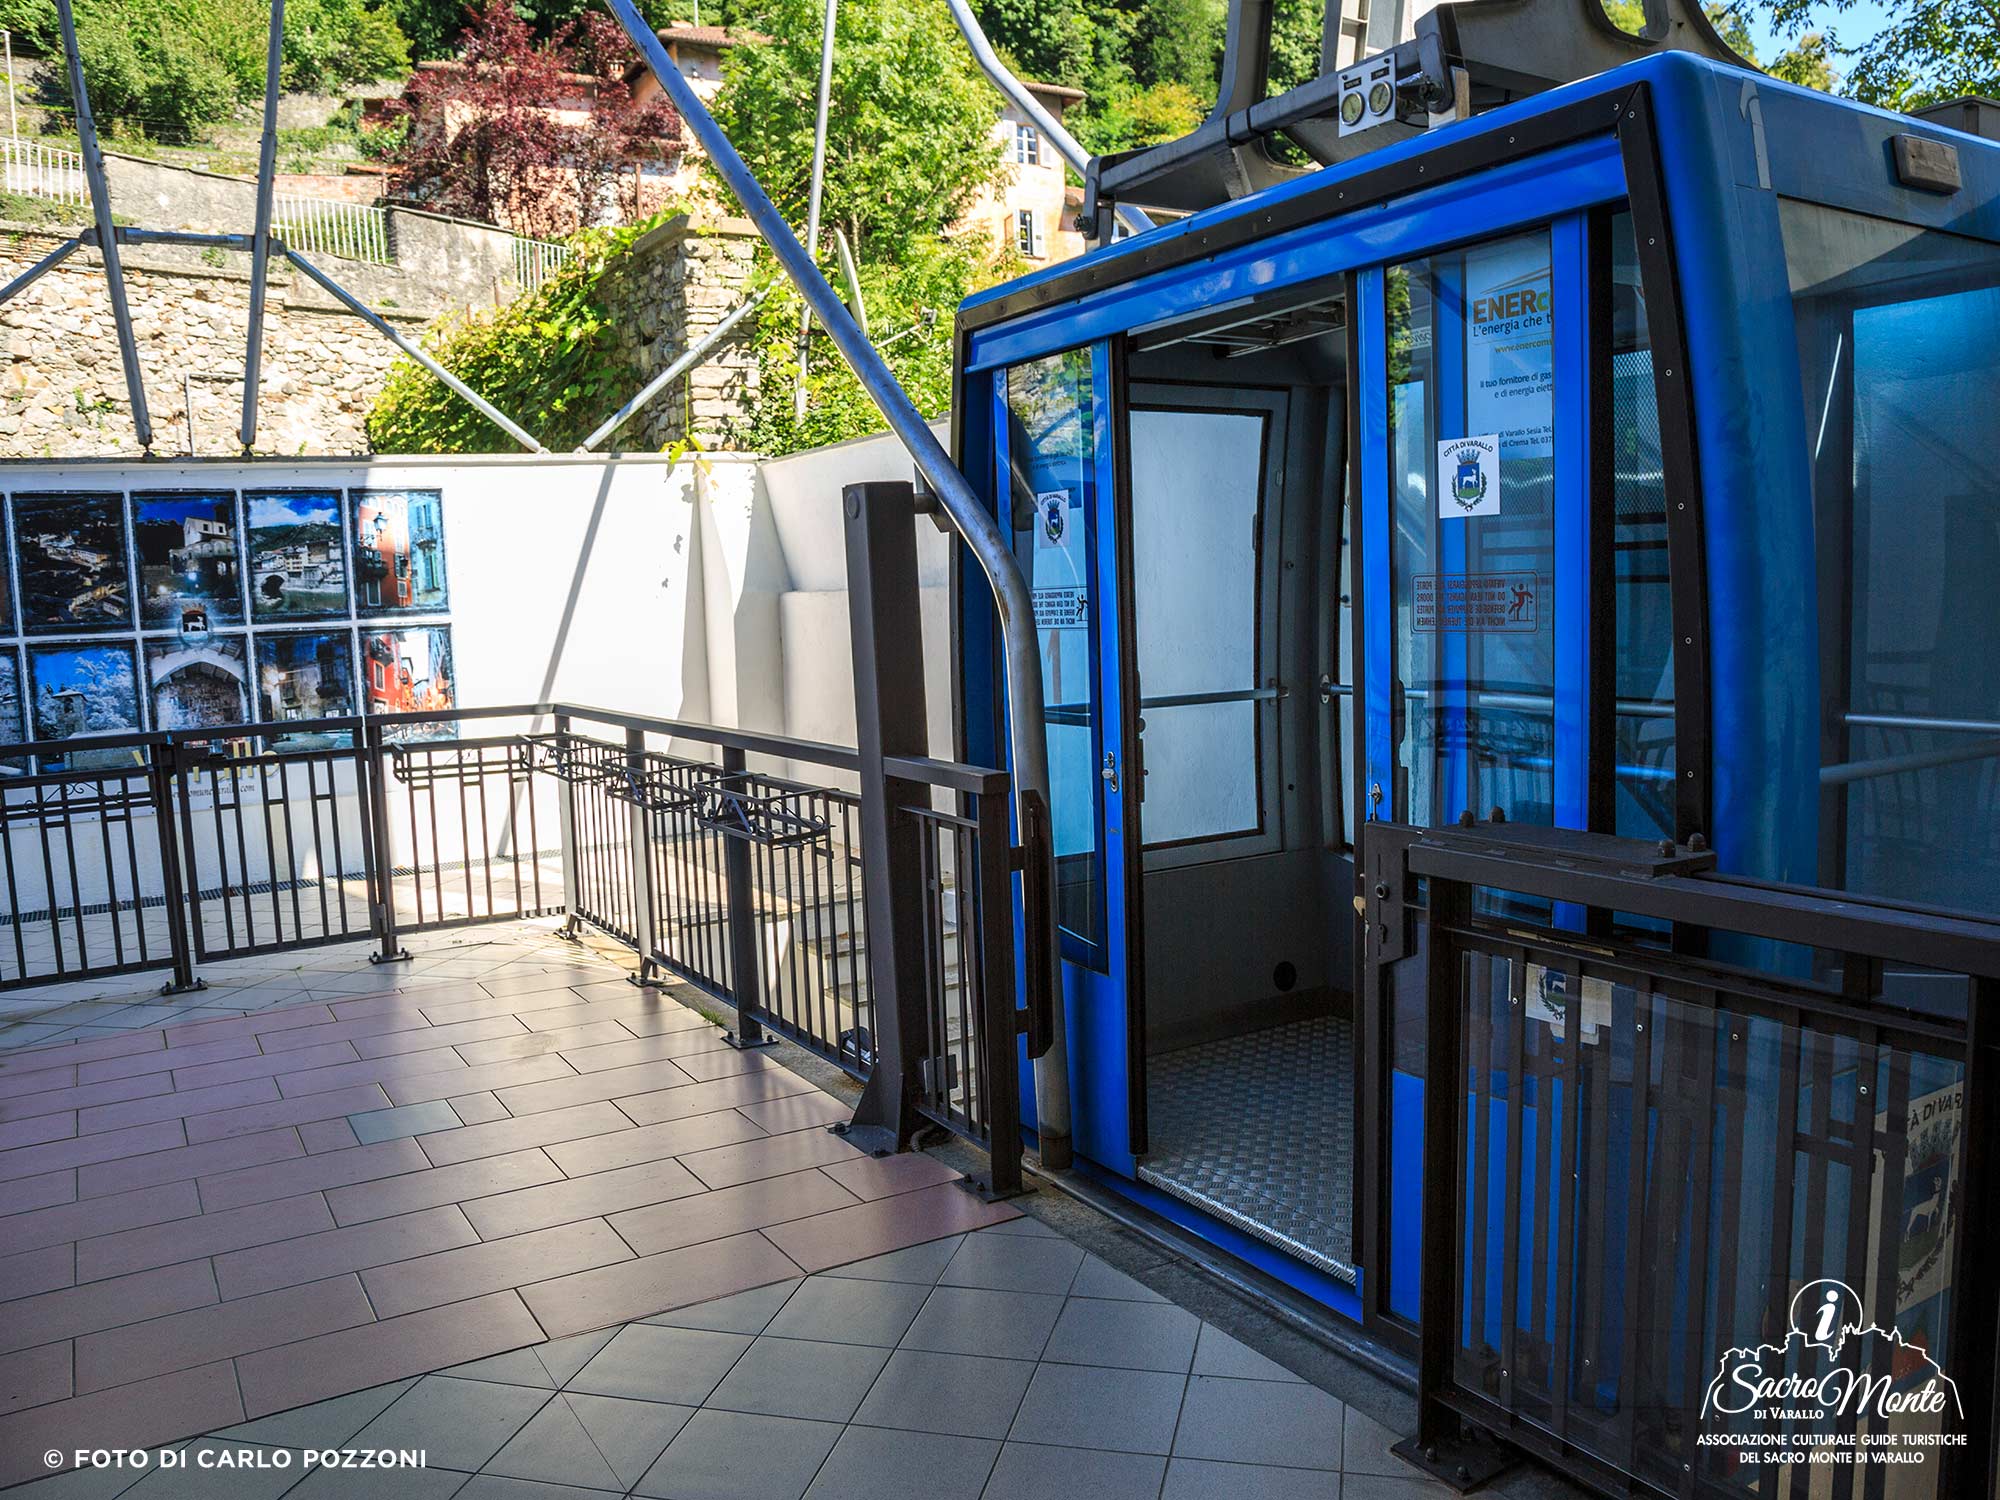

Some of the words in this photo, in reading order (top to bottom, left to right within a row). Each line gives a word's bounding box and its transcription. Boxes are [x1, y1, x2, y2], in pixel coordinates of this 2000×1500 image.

[1473, 289, 1552, 324] ENERc
[1473, 319, 1519, 337] L'energia
[1523, 315, 1542, 328] che
[1486, 379, 1498, 388] tuo
[1499, 375, 1530, 386] fornitore
[1531, 373, 1538, 381] di
[1540, 372, 1552, 382] gas
[1509, 385, 1535, 396] energia
[1505, 429, 1526, 438] Varallo
[1526, 426, 1541, 435] Sesia
[1443, 442, 1460, 457] CITTÀ
[1460, 440, 1467, 449] DI
[1466, 440, 1494, 453] VARALLO
[1509, 439, 1529, 448] Crema
